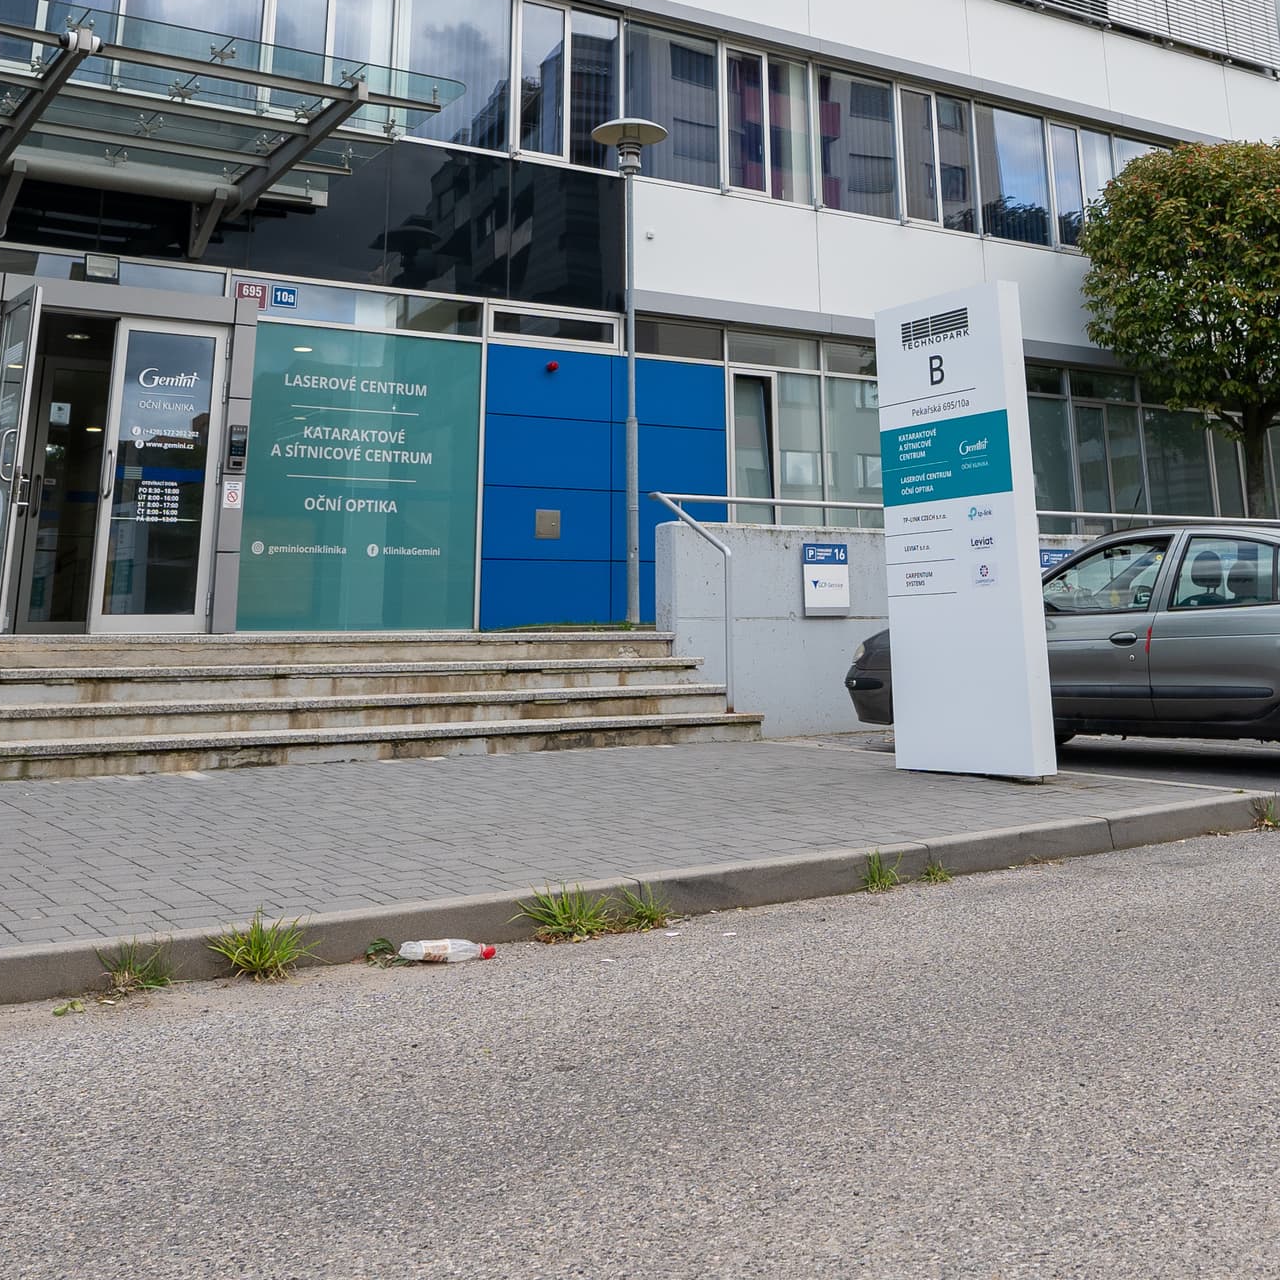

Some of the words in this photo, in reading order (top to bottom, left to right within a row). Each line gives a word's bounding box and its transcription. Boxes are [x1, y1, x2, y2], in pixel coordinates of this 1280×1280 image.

[242, 285, 262, 297] 695
[276, 291, 295, 303] 10a
[902, 328, 970, 351] TECHNOPARK
[929, 354, 945, 386] B
[139, 367, 201, 388] Gemini
[284, 373, 357, 391] LASEROVÉ
[360, 380, 428, 397] CENTRUM
[139, 400, 161, 409] OČNÍ
[162, 401, 195, 412] KLINIKA
[911, 405, 941, 417] Pekařská
[942, 399, 970, 411] 695/10a
[303, 425, 406, 444] KATARAKTOVÉ
[898, 428, 937, 442] KATARAKTOVÉ
[145, 441, 194, 450] www.gemini.cz
[904, 439, 931, 451] SÍTNICOVÉ
[271, 444, 281, 457] A
[285, 442, 361, 461] SÍTNICOVÉ
[365, 449, 433, 464] CENTRUM
[899, 451, 926, 461] CENTRUM
[901, 472, 925, 484] LASEROVÉ
[926, 470, 952, 480] CENTRUM
[304, 494, 342, 512] OČNÍ
[345, 499, 398, 513] OPTIKA
[970, 536, 994, 547] Leviat
[268, 543, 347, 555] geminiocniklinika
[383, 546, 441, 556] KlinikaGemini
[834, 549, 845, 560] 16
